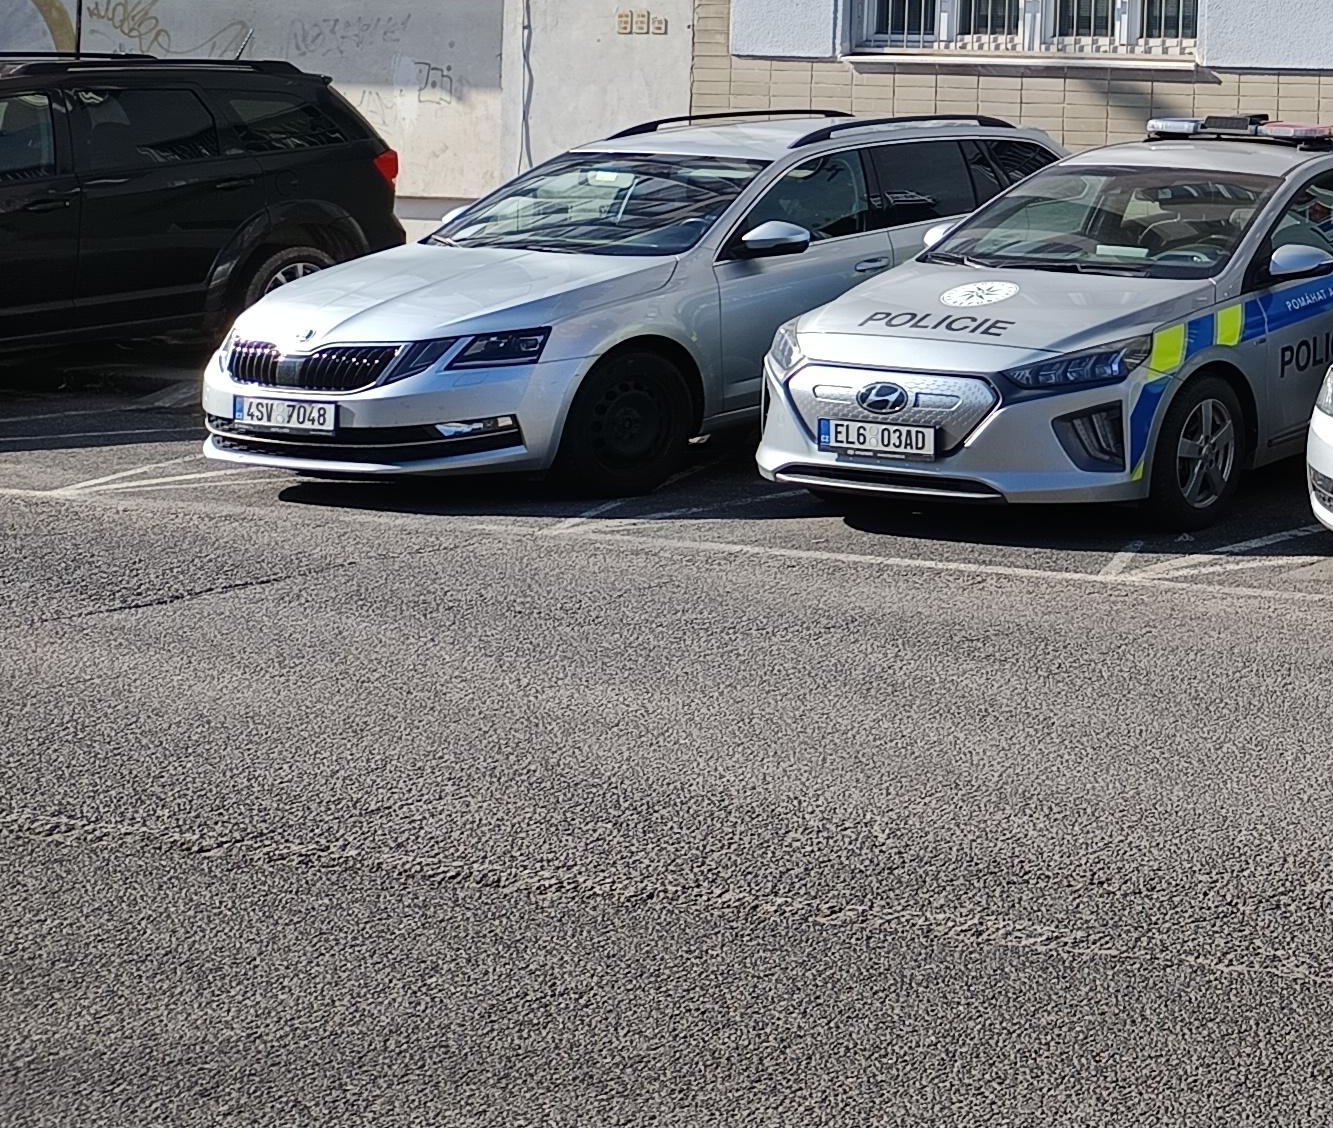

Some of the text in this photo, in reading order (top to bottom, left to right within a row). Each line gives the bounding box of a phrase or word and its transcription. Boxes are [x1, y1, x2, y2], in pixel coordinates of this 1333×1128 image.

[1285, 290, 1328, 311] POMÁHAT
[857, 311, 1017, 337] POLICIE
[246, 401, 327, 426] 4SV 7048
[834, 423, 867, 445] EL6
